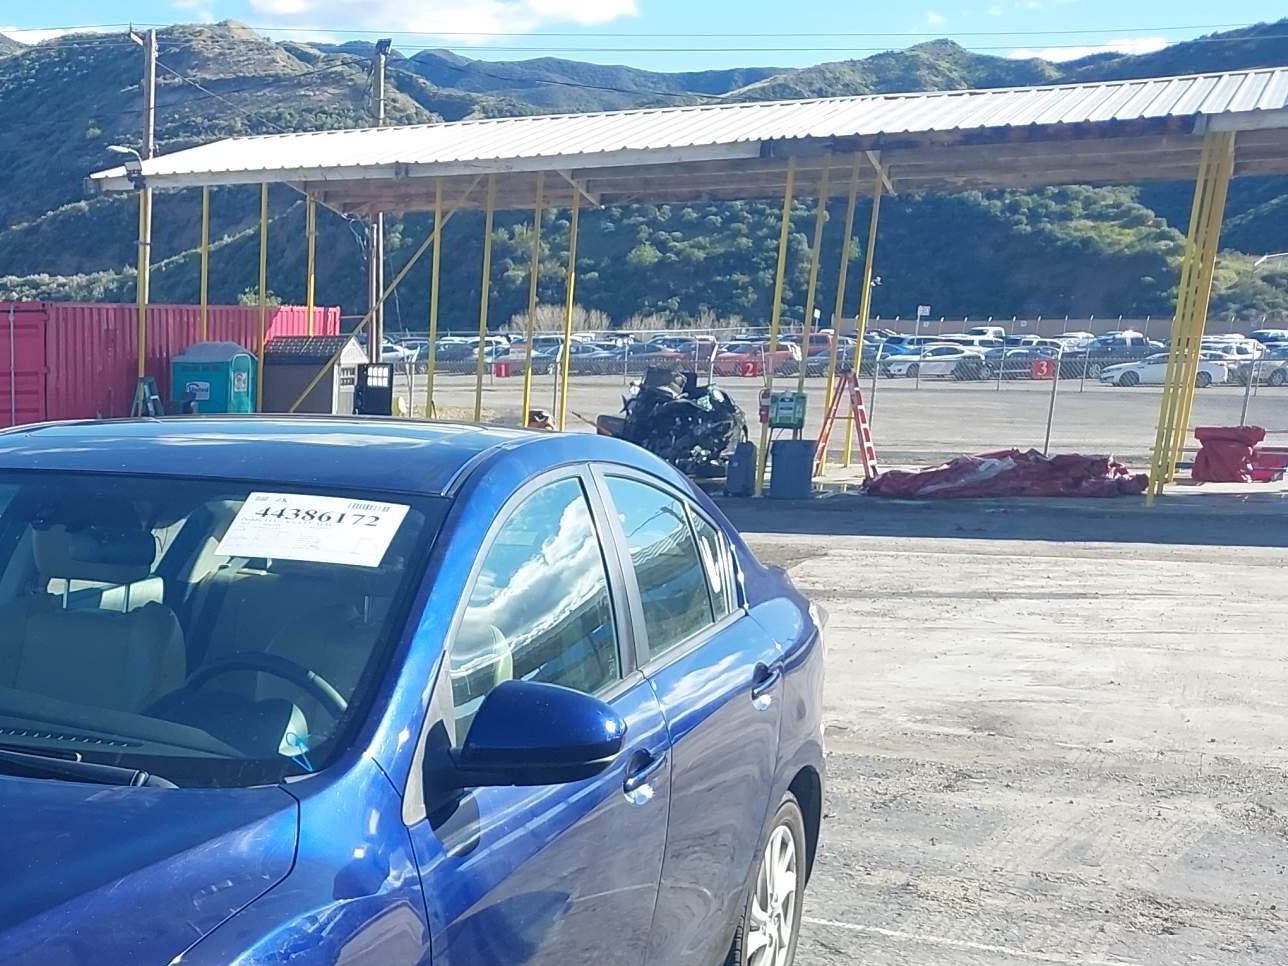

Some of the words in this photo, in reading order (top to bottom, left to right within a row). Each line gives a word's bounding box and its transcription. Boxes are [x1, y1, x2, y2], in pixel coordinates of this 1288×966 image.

[744, 362, 754, 376] 2
[1037, 361, 1048, 376] 3
[255, 506, 381, 527] 44386172
